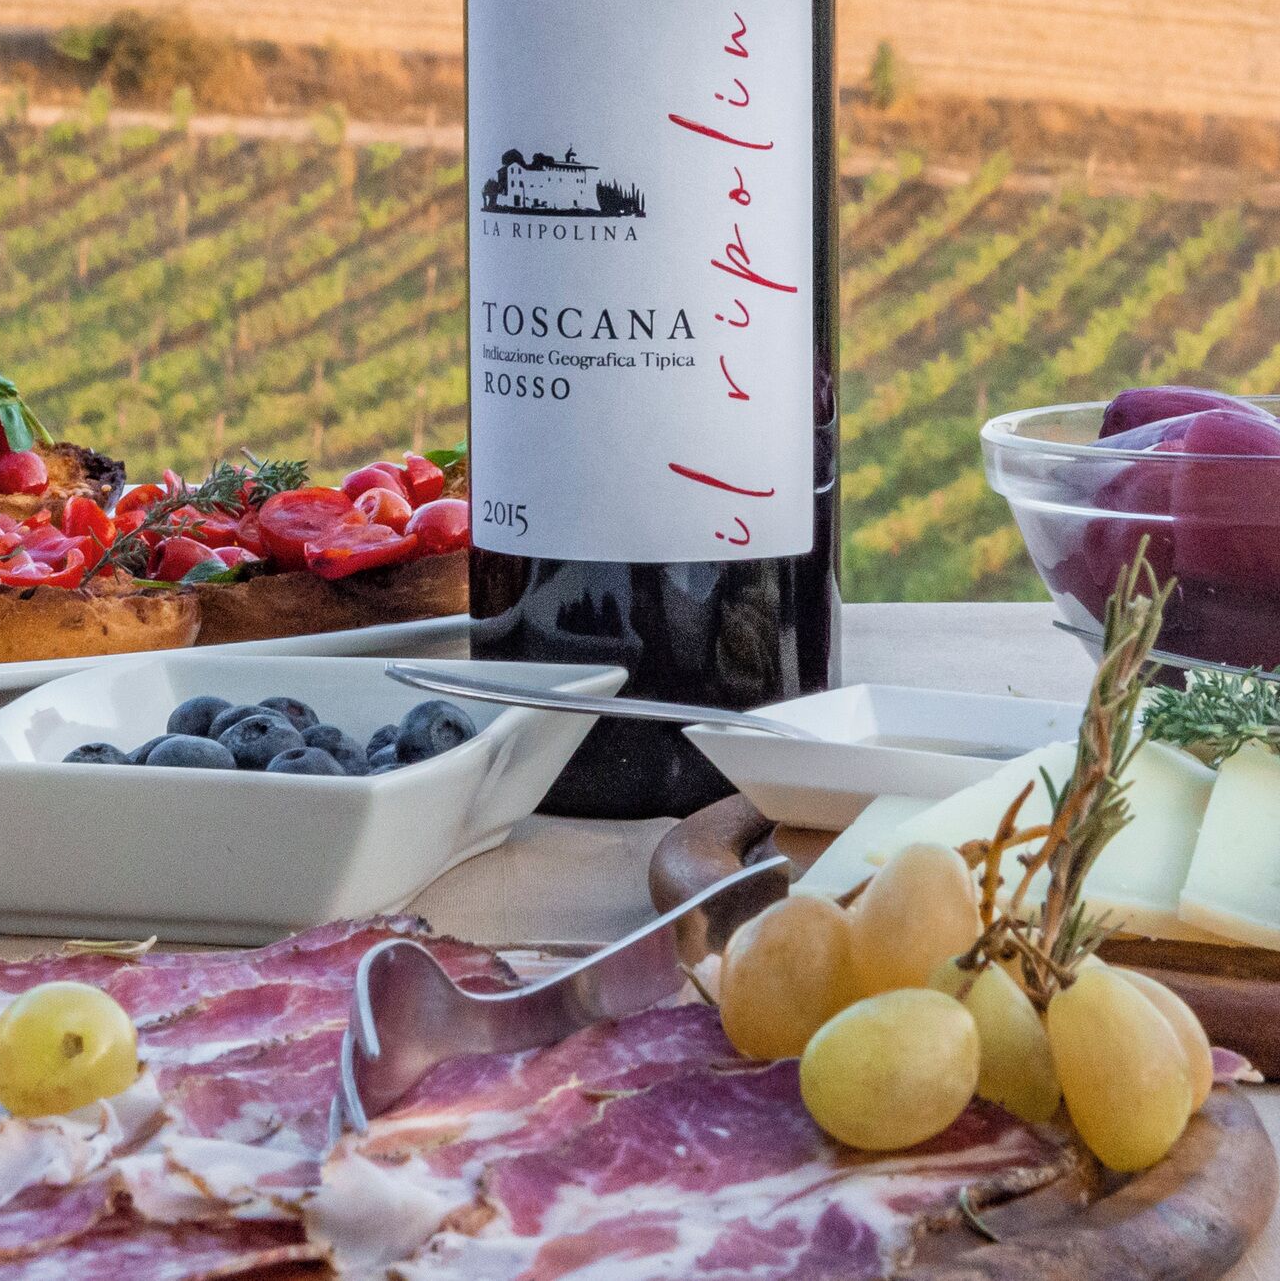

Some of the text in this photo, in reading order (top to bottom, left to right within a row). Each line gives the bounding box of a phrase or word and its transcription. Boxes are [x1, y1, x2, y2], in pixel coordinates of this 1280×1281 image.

[482, 219, 638, 241] LA RIPOLINA
[482, 301, 696, 340] TOSCANA
[482, 344, 696, 371] Indicazione Geografica Tipica
[484, 371, 571, 400] ROSSO
[483, 500, 529, 536] 2015
[668, 462, 775, 546] il
